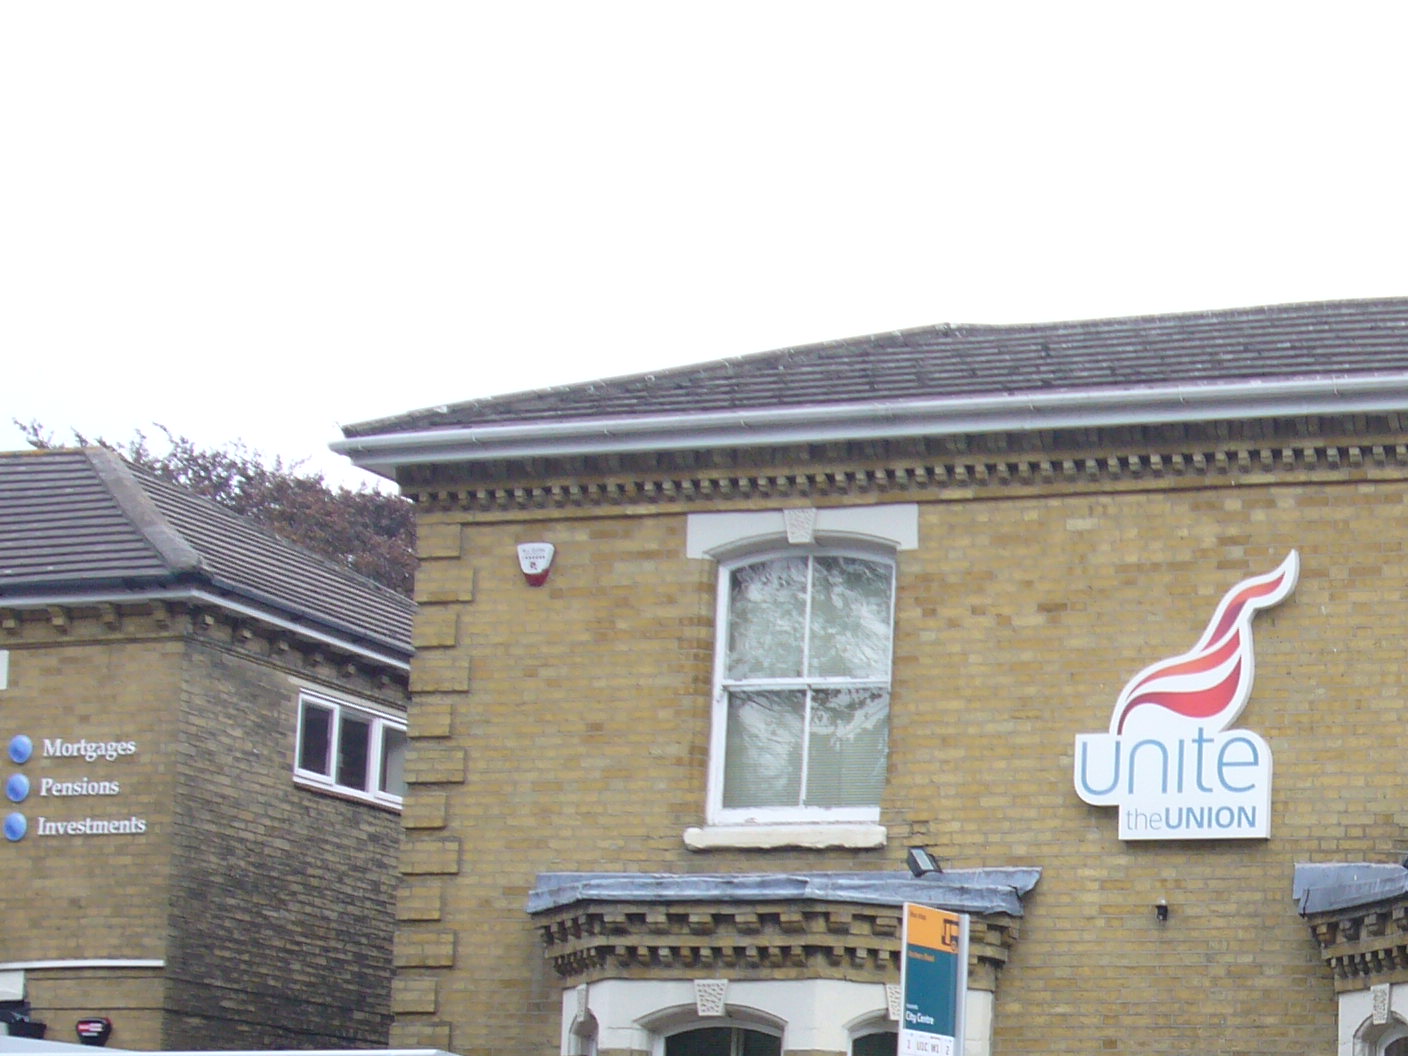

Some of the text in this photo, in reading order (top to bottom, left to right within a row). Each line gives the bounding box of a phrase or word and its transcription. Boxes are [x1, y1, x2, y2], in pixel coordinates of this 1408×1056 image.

[42, 738, 136, 761] Mortgages
[1081, 727, 1259, 796] unite
[40, 778, 120, 797] Pensions
[37, 816, 147, 837] Investments
